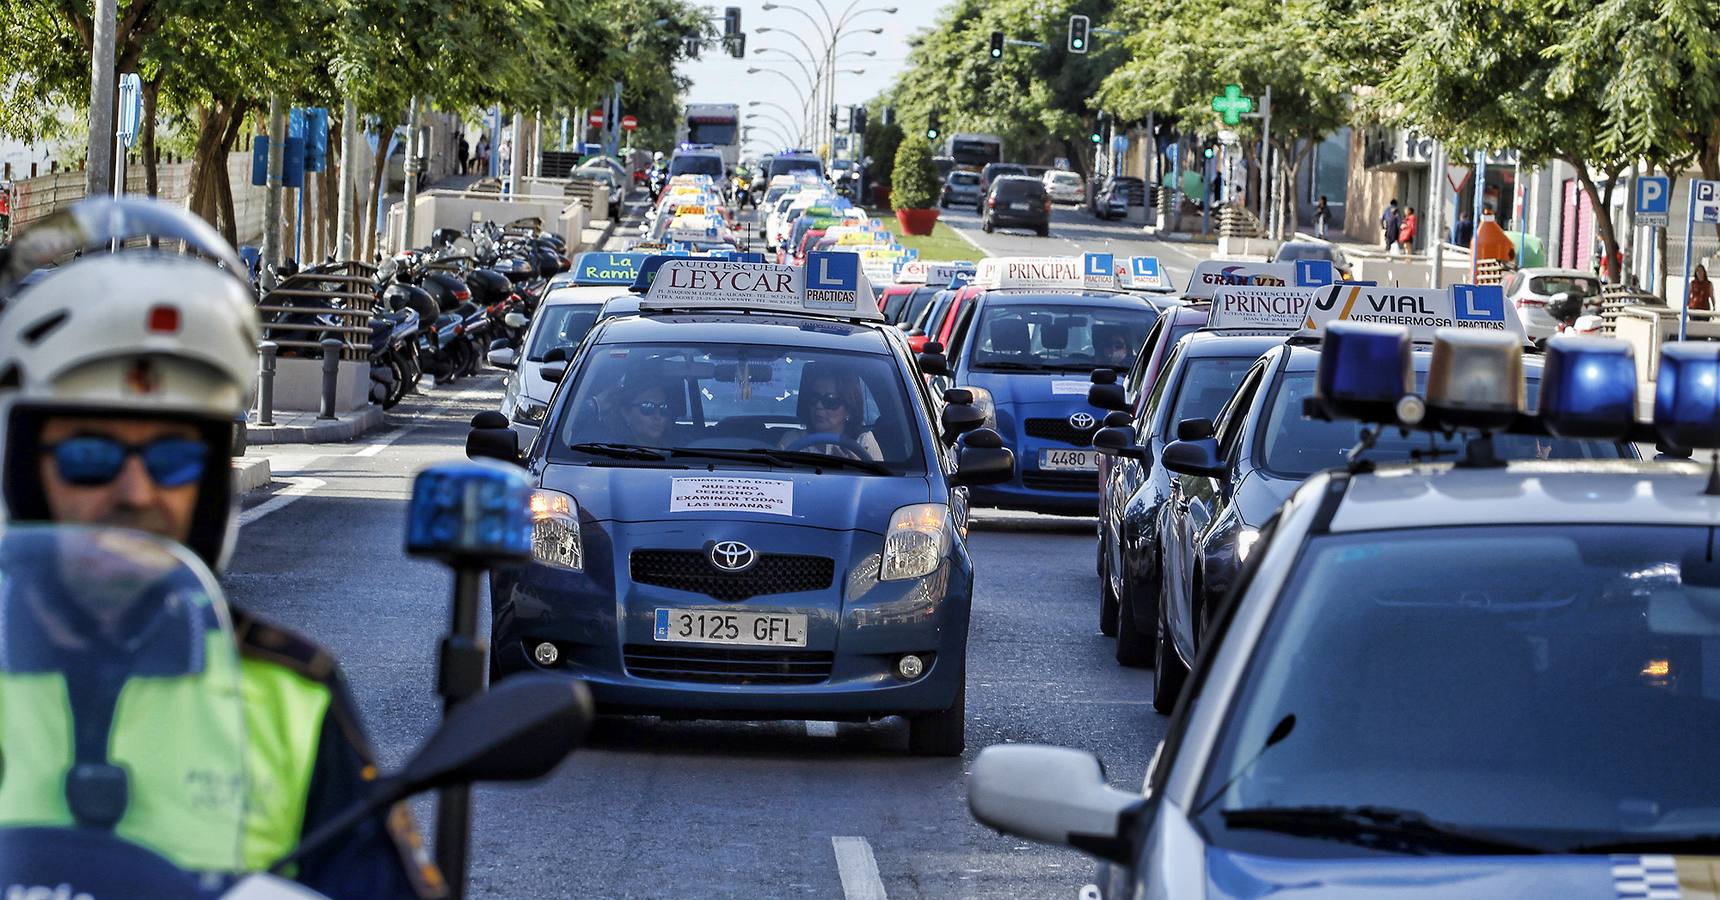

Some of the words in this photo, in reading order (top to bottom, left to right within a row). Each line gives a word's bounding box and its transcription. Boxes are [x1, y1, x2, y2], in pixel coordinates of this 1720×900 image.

[1642, 181, 1661, 209] P
[1700, 184, 1712, 200] P
[609, 255, 632, 267] La
[673, 261, 718, 269] AUTO
[723, 263, 795, 272] ESCUELA
[1091, 256, 1106, 274] L
[1137, 259, 1153, 275] L
[585, 266, 639, 280] Ramb
[819, 258, 844, 285] L
[1008, 263, 1080, 280] PRINCIPAL
[1304, 264, 1322, 284] L
[668, 268, 796, 294] LEYCAR
[1202, 273, 1248, 286] GRAN
[1254, 277, 1286, 287] VIA
[806, 289, 855, 303] PRACTICAS
[1465, 290, 1491, 317] L
[1366, 294, 1435, 315] VIAL
[1350, 314, 1453, 327] VISTAHERMOSA
[1457, 320, 1505, 331] PRACTICAS
[1050, 452, 1086, 466] 4480
[713, 502, 772, 510] SEMANAS
[743, 496, 784, 504] TODAS
[678, 614, 740, 640] 3125
[752, 616, 799, 643] GFL
